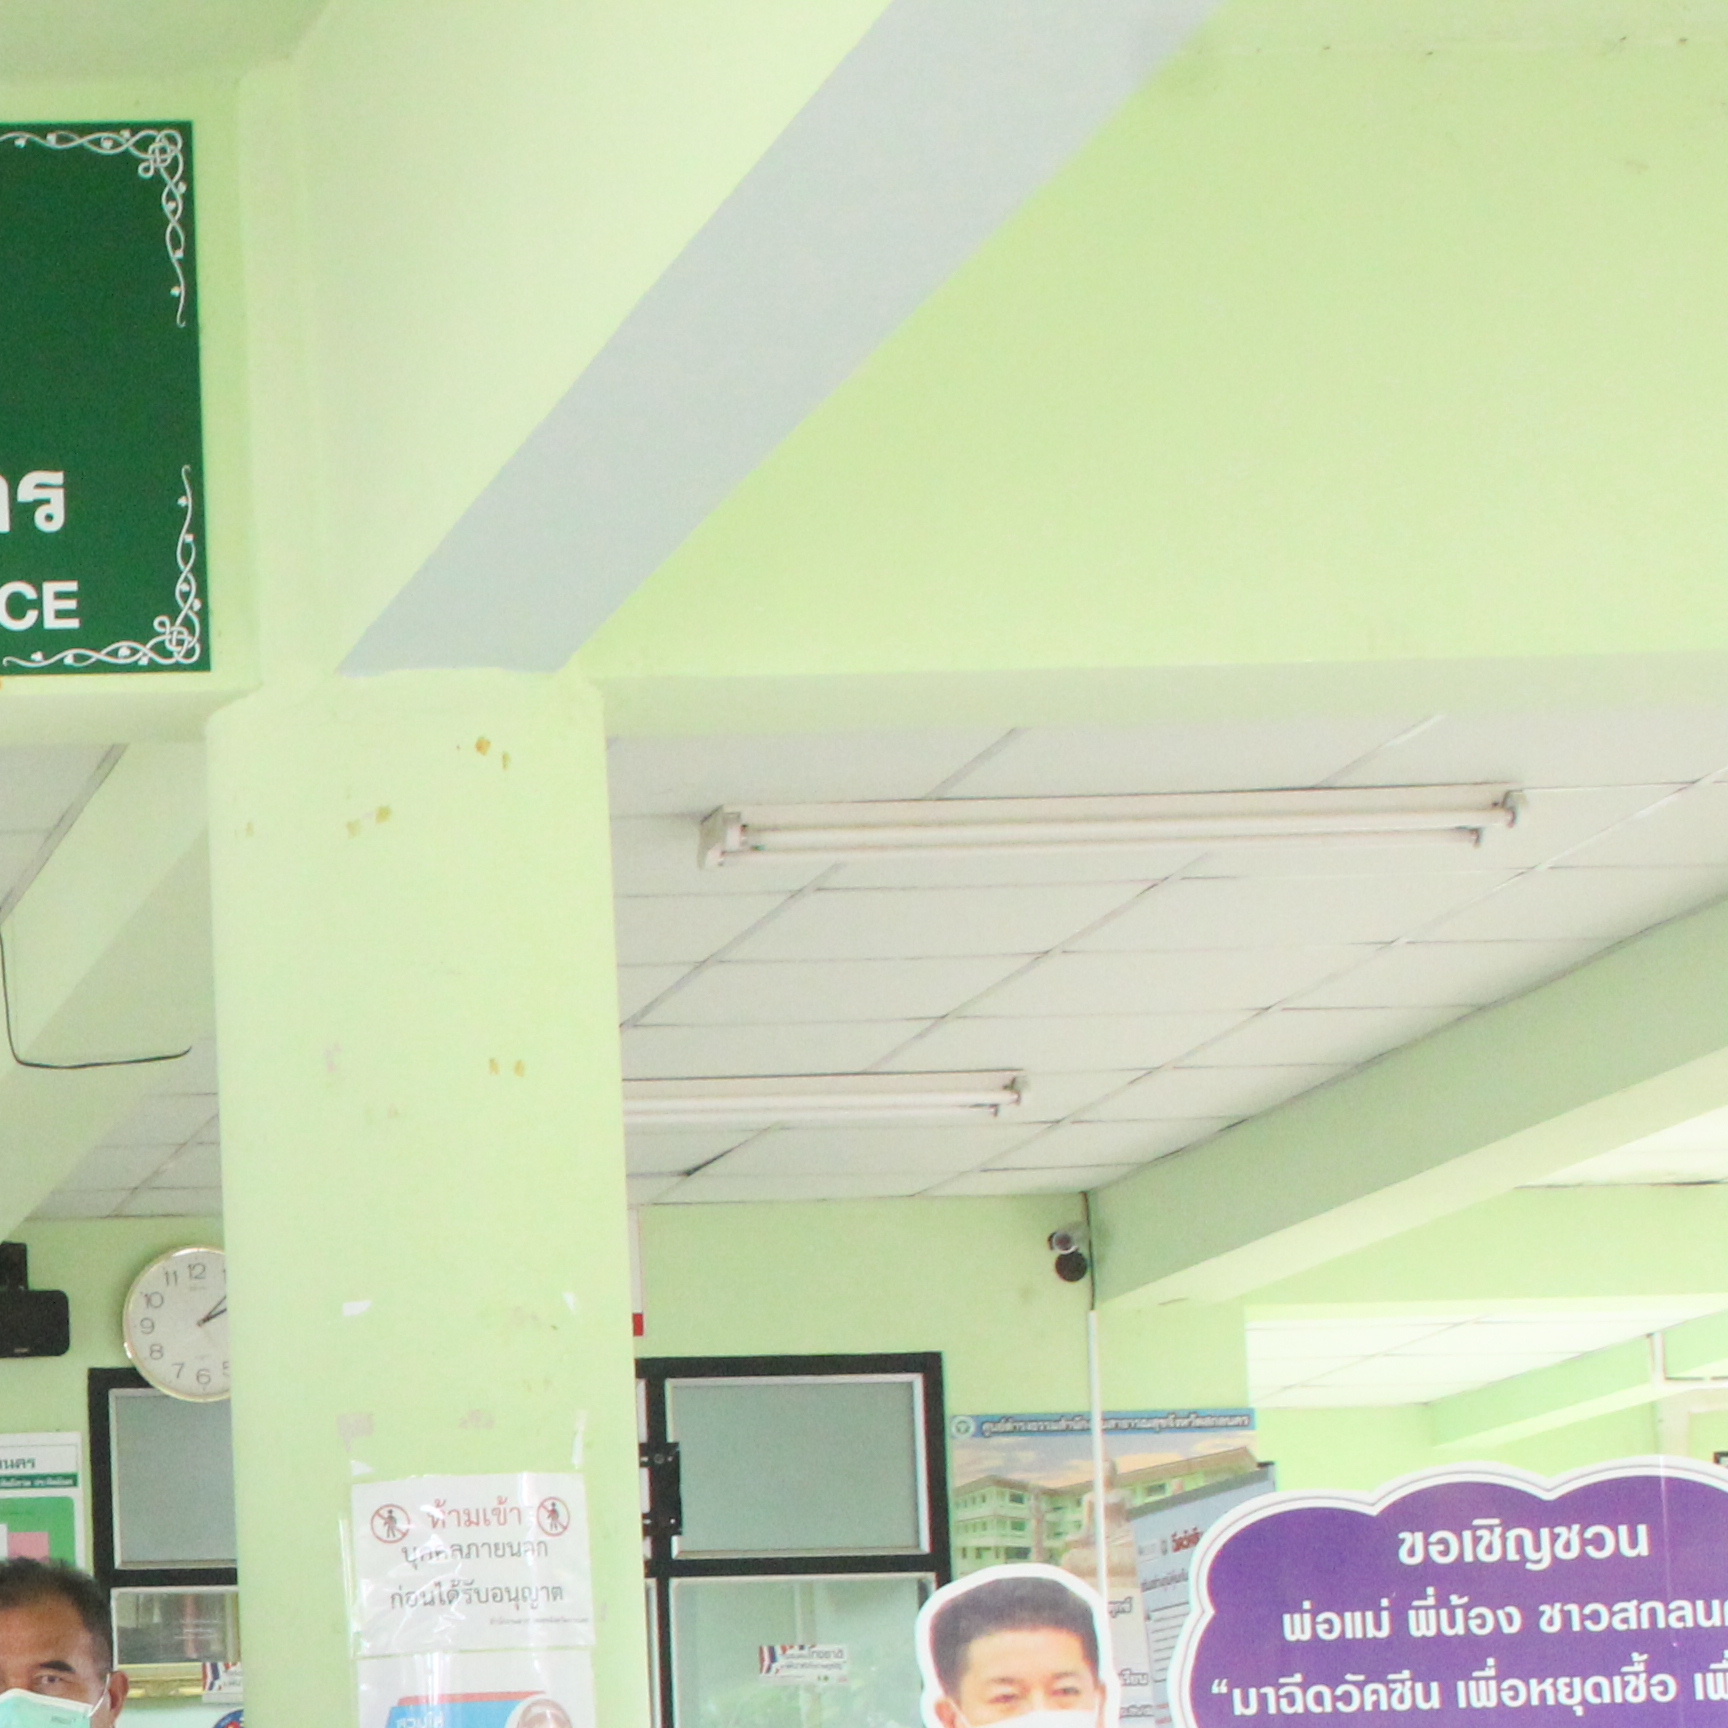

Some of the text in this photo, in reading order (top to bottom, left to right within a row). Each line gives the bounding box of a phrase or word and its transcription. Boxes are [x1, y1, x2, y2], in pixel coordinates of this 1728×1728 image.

[165, 1270, 178, 1287] 11
[187, 1263, 206, 1279] 12
[144, 1291, 164, 1309] 10
[140, 1317, 154, 1335] 9
[149, 1343, 163, 1360] 8
[172, 1362, 184, 1379] 7
[196, 1369, 211, 1385] 6
[1397, 1518, 1650, 1571] ขอเชิญชวน
[1282, 1586, 1728, 1642] พ่อแม่ พี่น้อง ชาวสกลน
[1211, 1669, 1441, 1717] “มาฉีดวัคซีน
[1456, 1652, 1678, 1717] เพื่อหยุดเชื้อ
